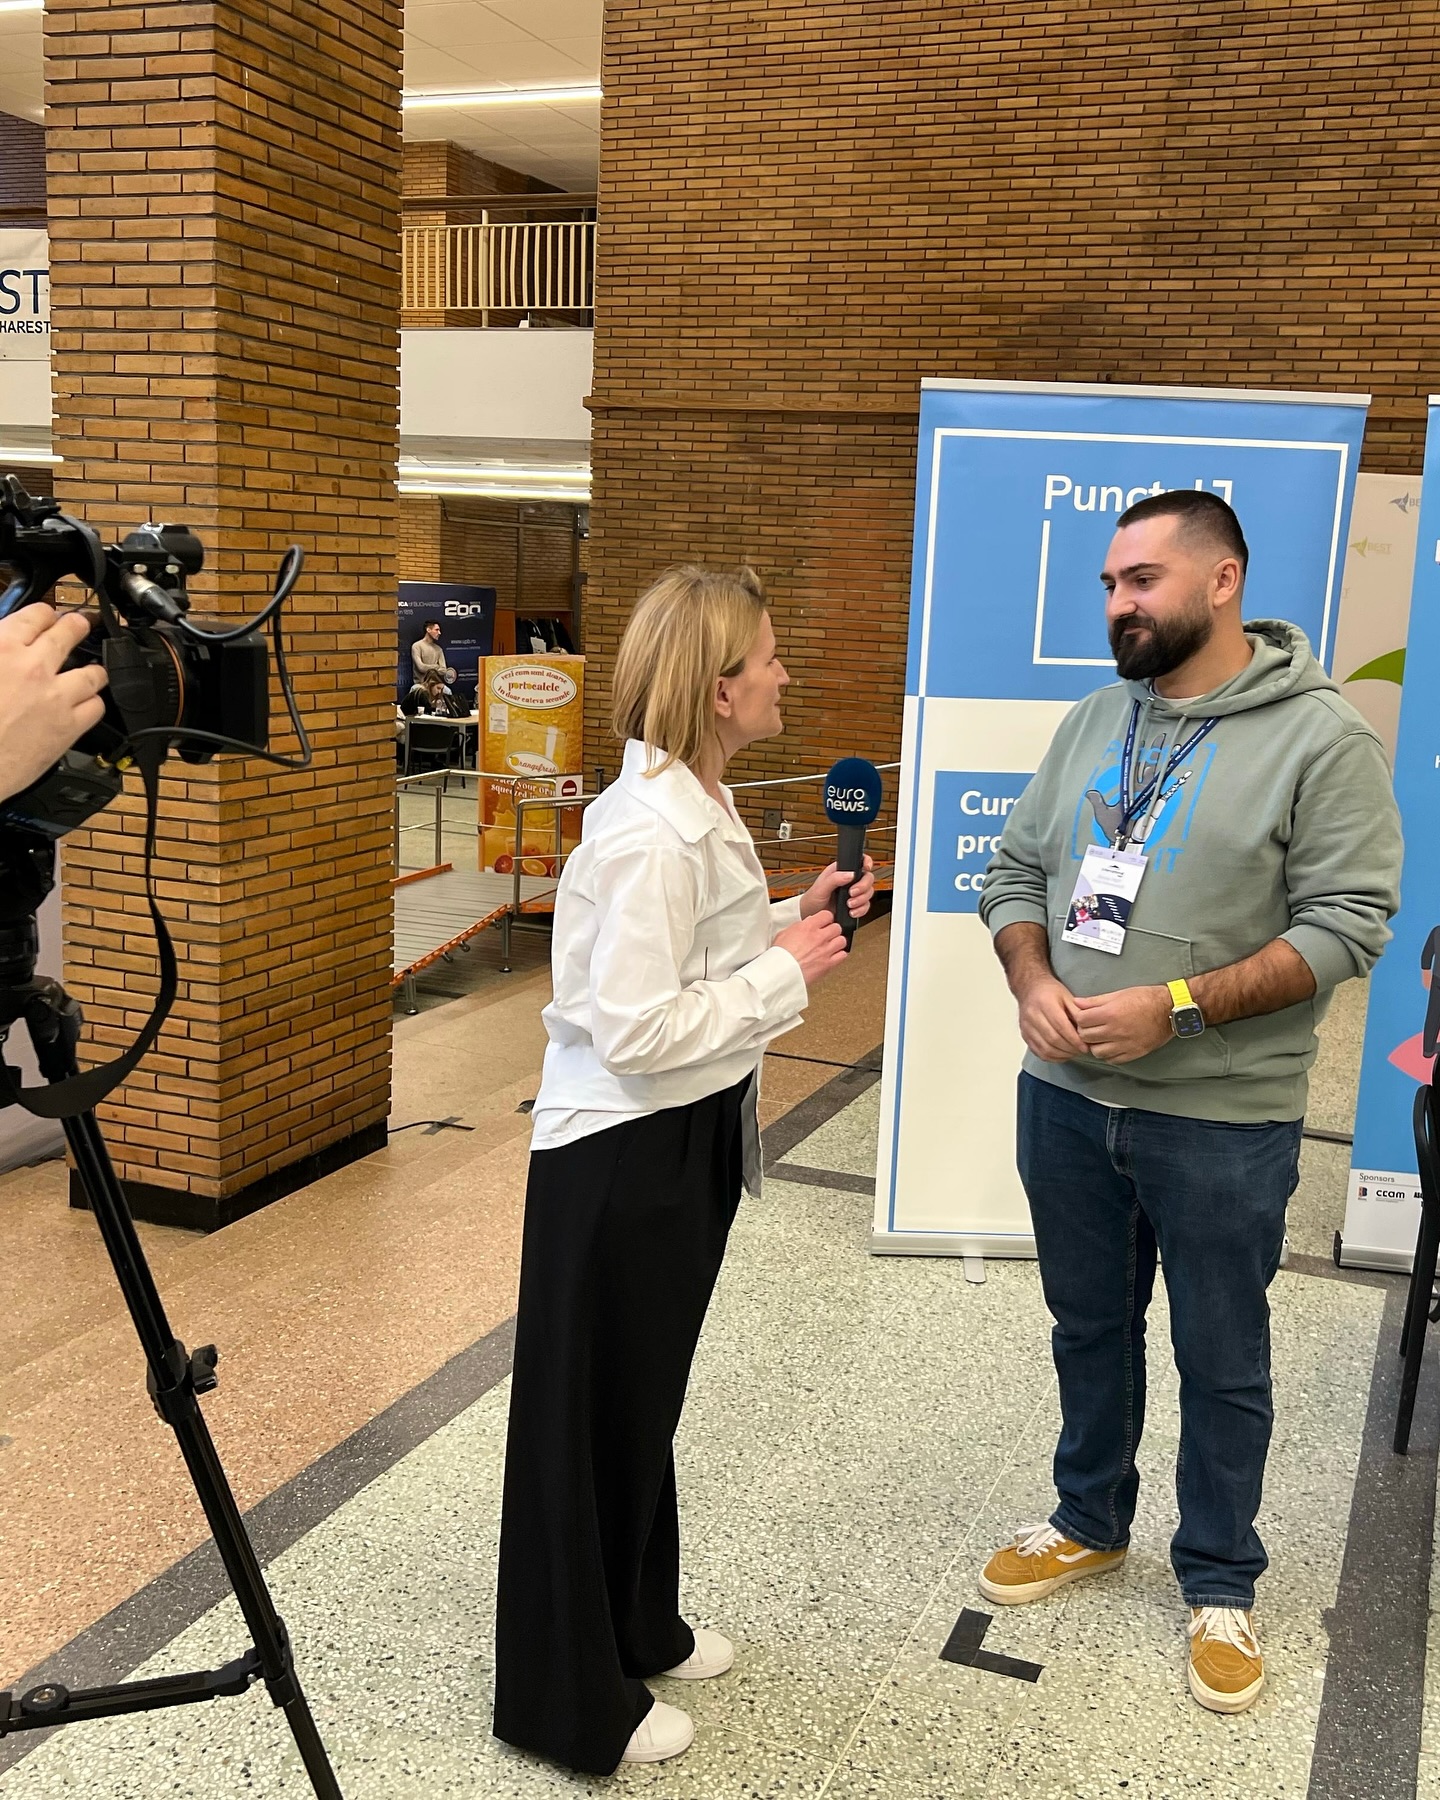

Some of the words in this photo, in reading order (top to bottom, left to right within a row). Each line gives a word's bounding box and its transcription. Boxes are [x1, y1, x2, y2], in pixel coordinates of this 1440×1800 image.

[0, 269, 49, 314] ST
[0, 320, 50, 333] HAREST
[827, 785, 865, 800] euro
[960, 790, 1020, 816] Cur
[1153, 848, 1184, 874] IT
[1359, 1172, 1395, 1183] Sponsors
[1376, 1189, 1405, 1199] ccam
